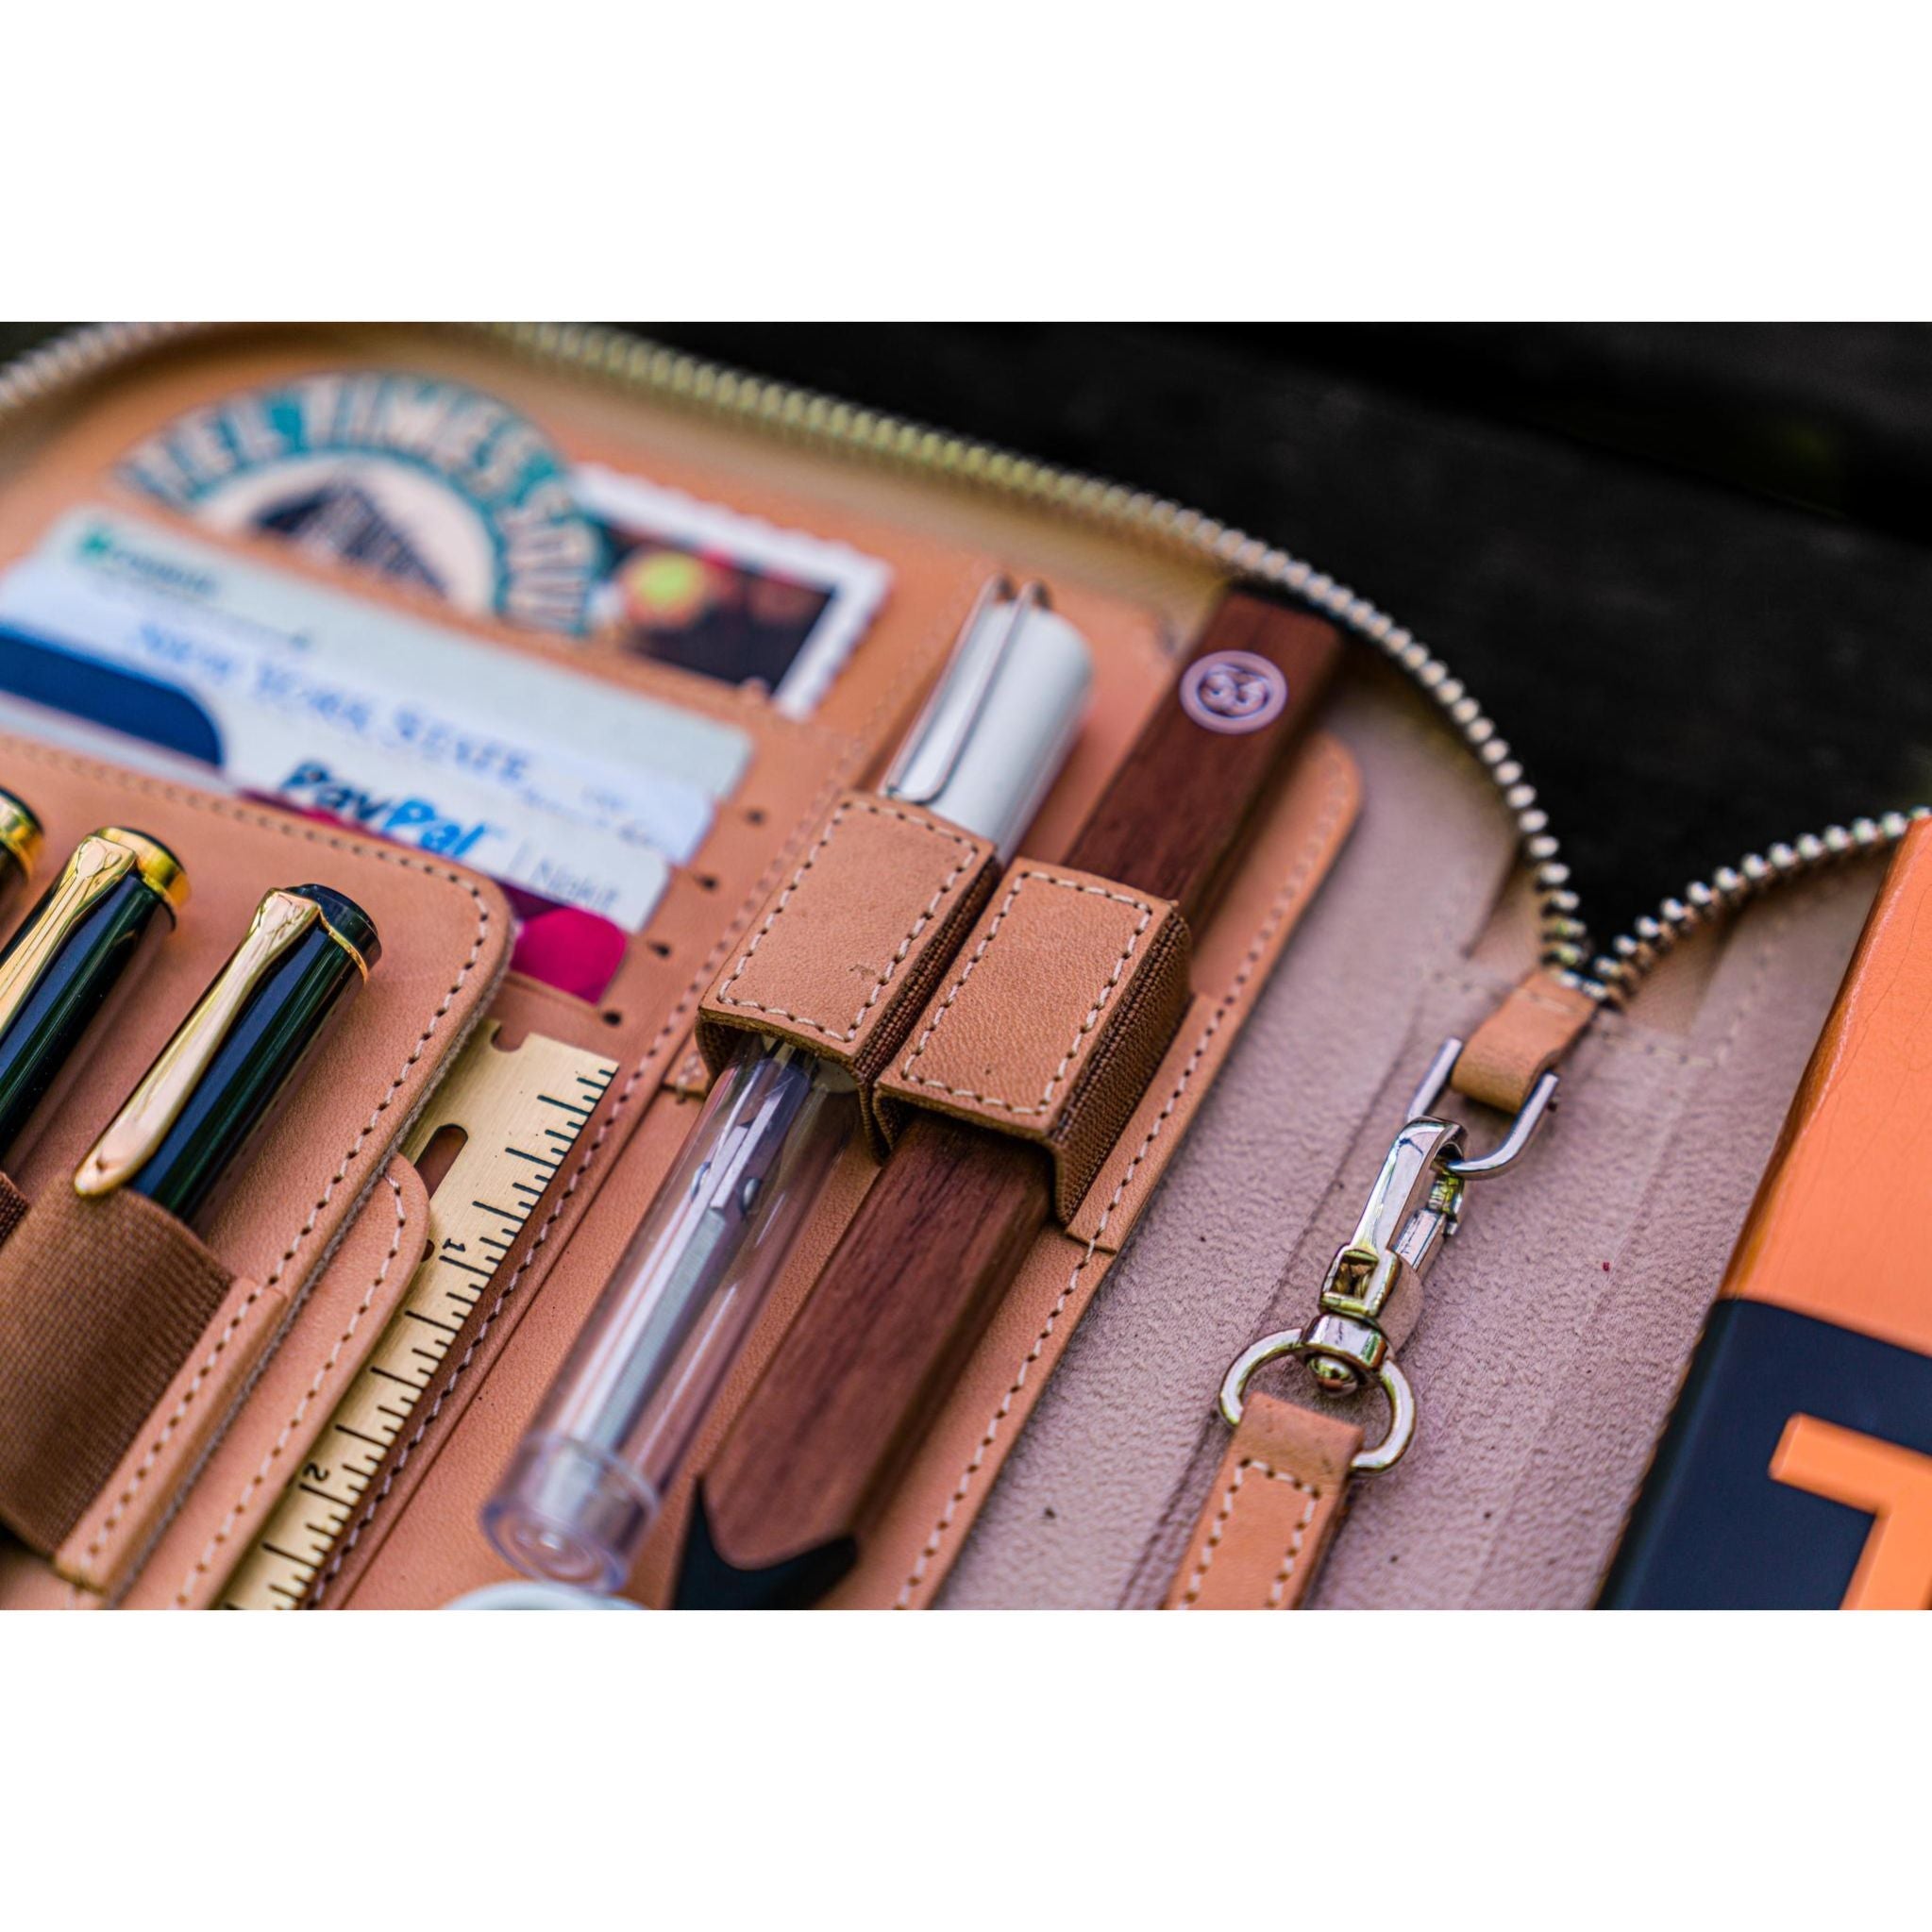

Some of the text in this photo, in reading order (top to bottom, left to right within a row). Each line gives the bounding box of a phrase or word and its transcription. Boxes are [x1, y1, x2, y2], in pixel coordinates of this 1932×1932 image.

[281, 759, 489, 860] PayPal
[443, 1237, 466, 1252] 1
[302, 1462, 330, 1482] 2
